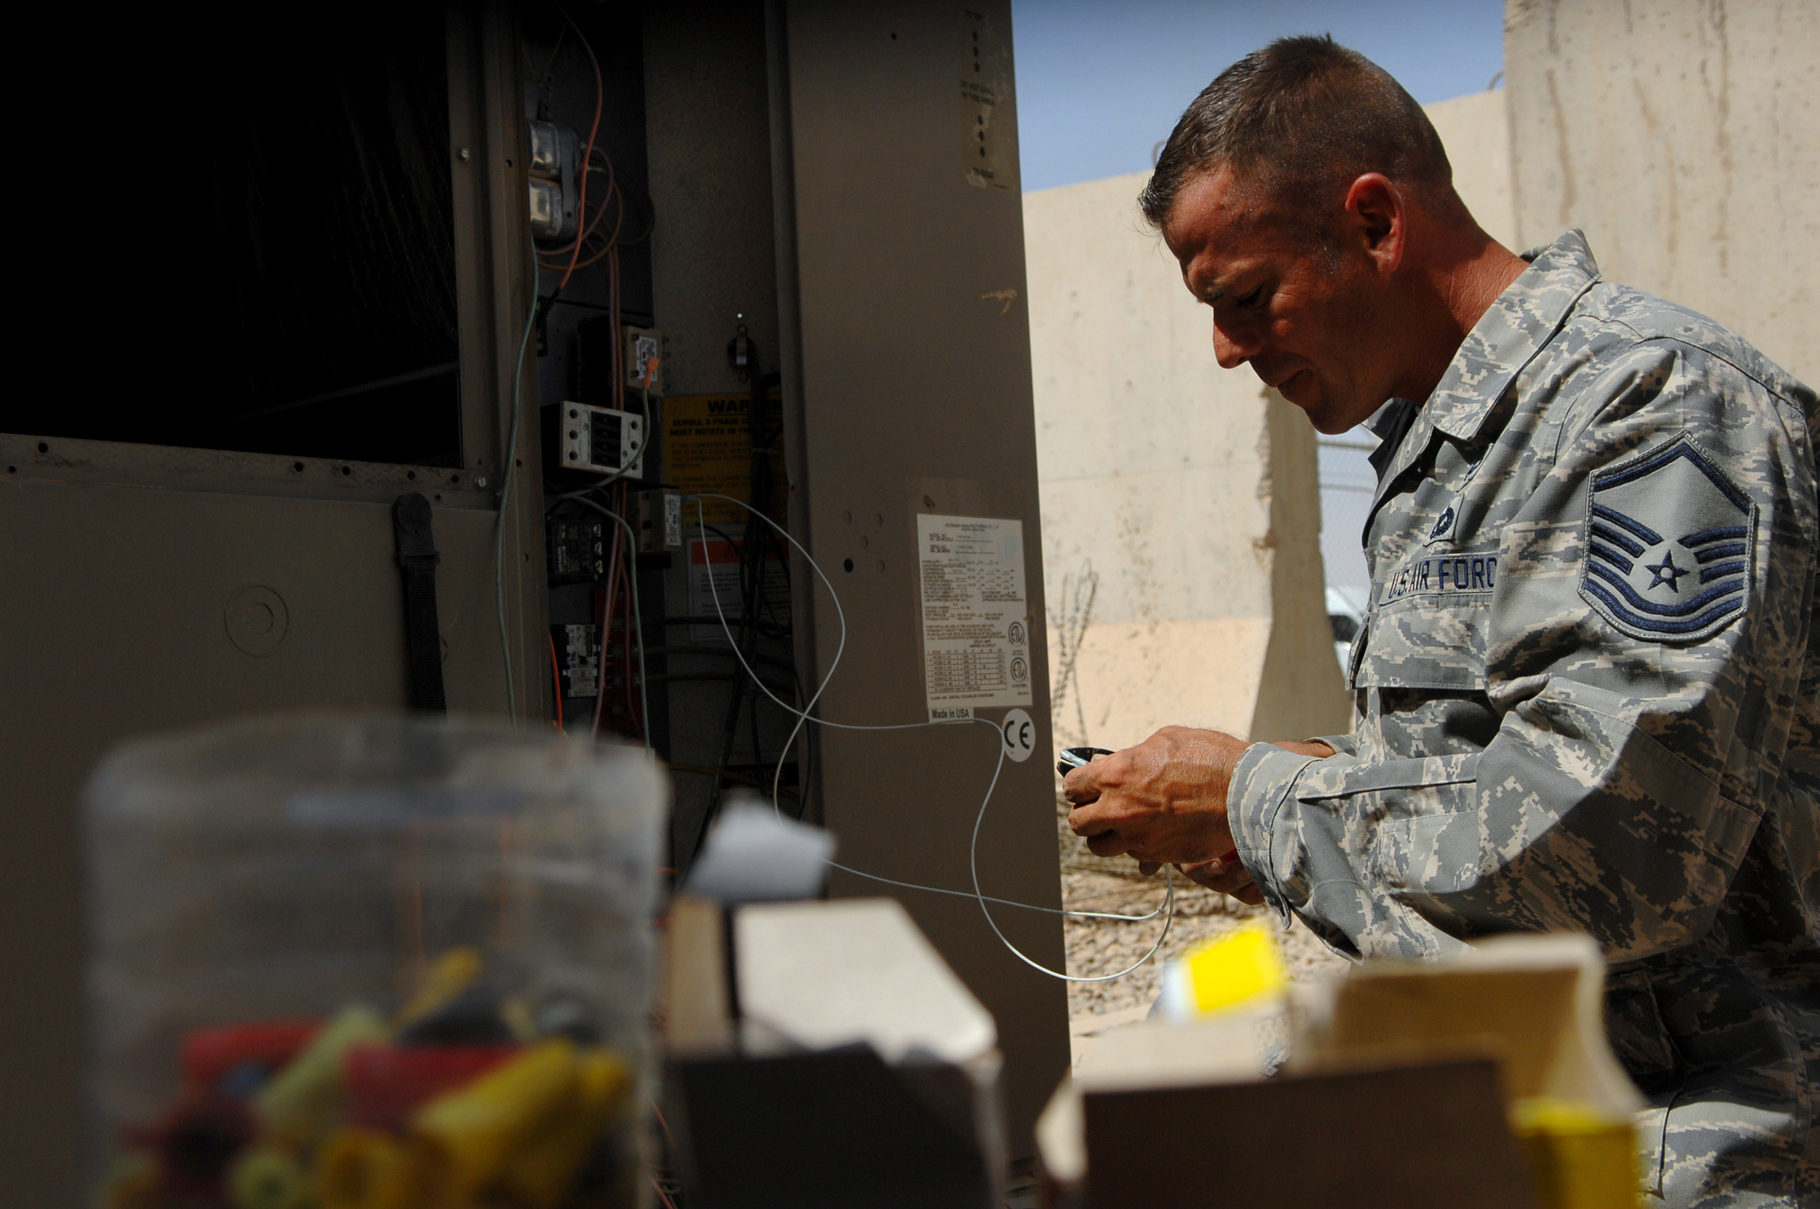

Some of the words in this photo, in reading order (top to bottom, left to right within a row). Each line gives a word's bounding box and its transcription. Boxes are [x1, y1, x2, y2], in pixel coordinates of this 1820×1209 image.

[707, 400, 782, 412] WARIN
[712, 417, 738, 425] PHASE
[694, 427, 724, 436] ROTATE
[1409, 560, 1429, 592] AIR
[1438, 557, 1497, 590] FORC
[932, 708, 948, 719] Made
[949, 709, 956, 719] in
[956, 709, 970, 719] USA
